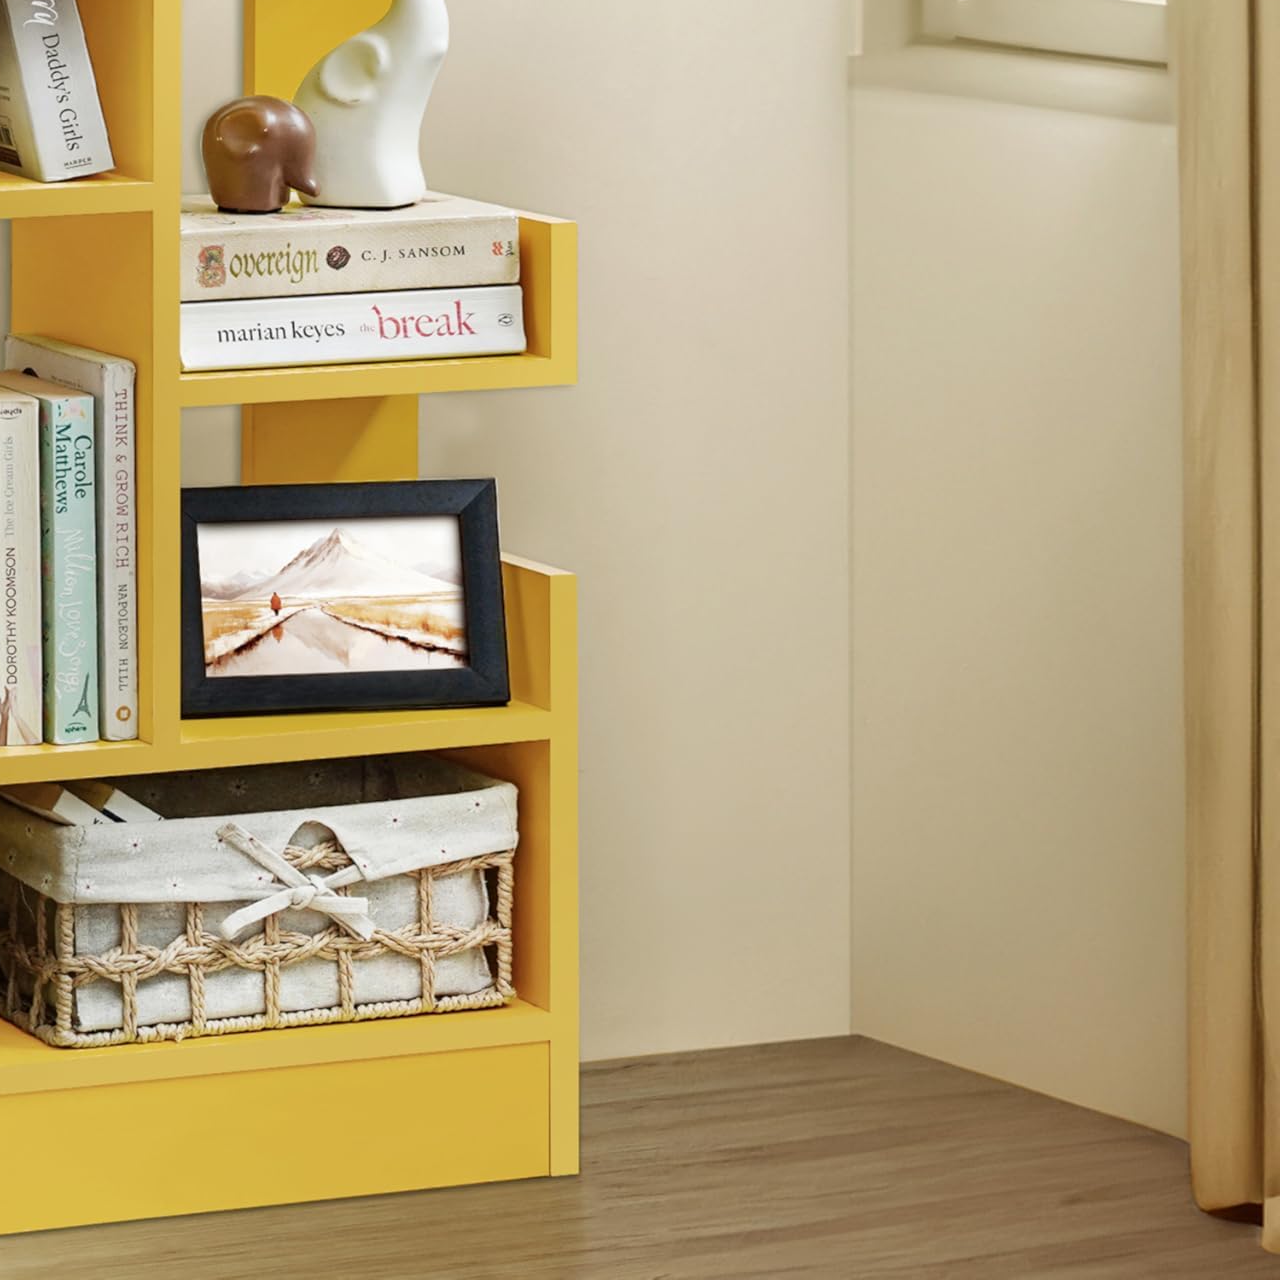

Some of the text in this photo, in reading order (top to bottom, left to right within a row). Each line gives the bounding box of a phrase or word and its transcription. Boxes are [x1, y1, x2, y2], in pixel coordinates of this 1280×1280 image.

[42, 33, 84, 152] Daddy's Girls
[361, 245, 466, 263] C. J. SANSOM
[217, 299, 478, 343] marian keyes the break
[3, 464, 14, 497] Cream
[55, 424, 72, 514] Matthews
[73, 435, 93, 499] Carole
[114, 388, 129, 568] THINK & GROW RICH
[4, 519, 15, 538] The
[55, 527, 94, 597] Million
[5, 547, 18, 685] DOROTHY KOOMSON
[118, 584, 129, 692] NAPOLEON HILL
